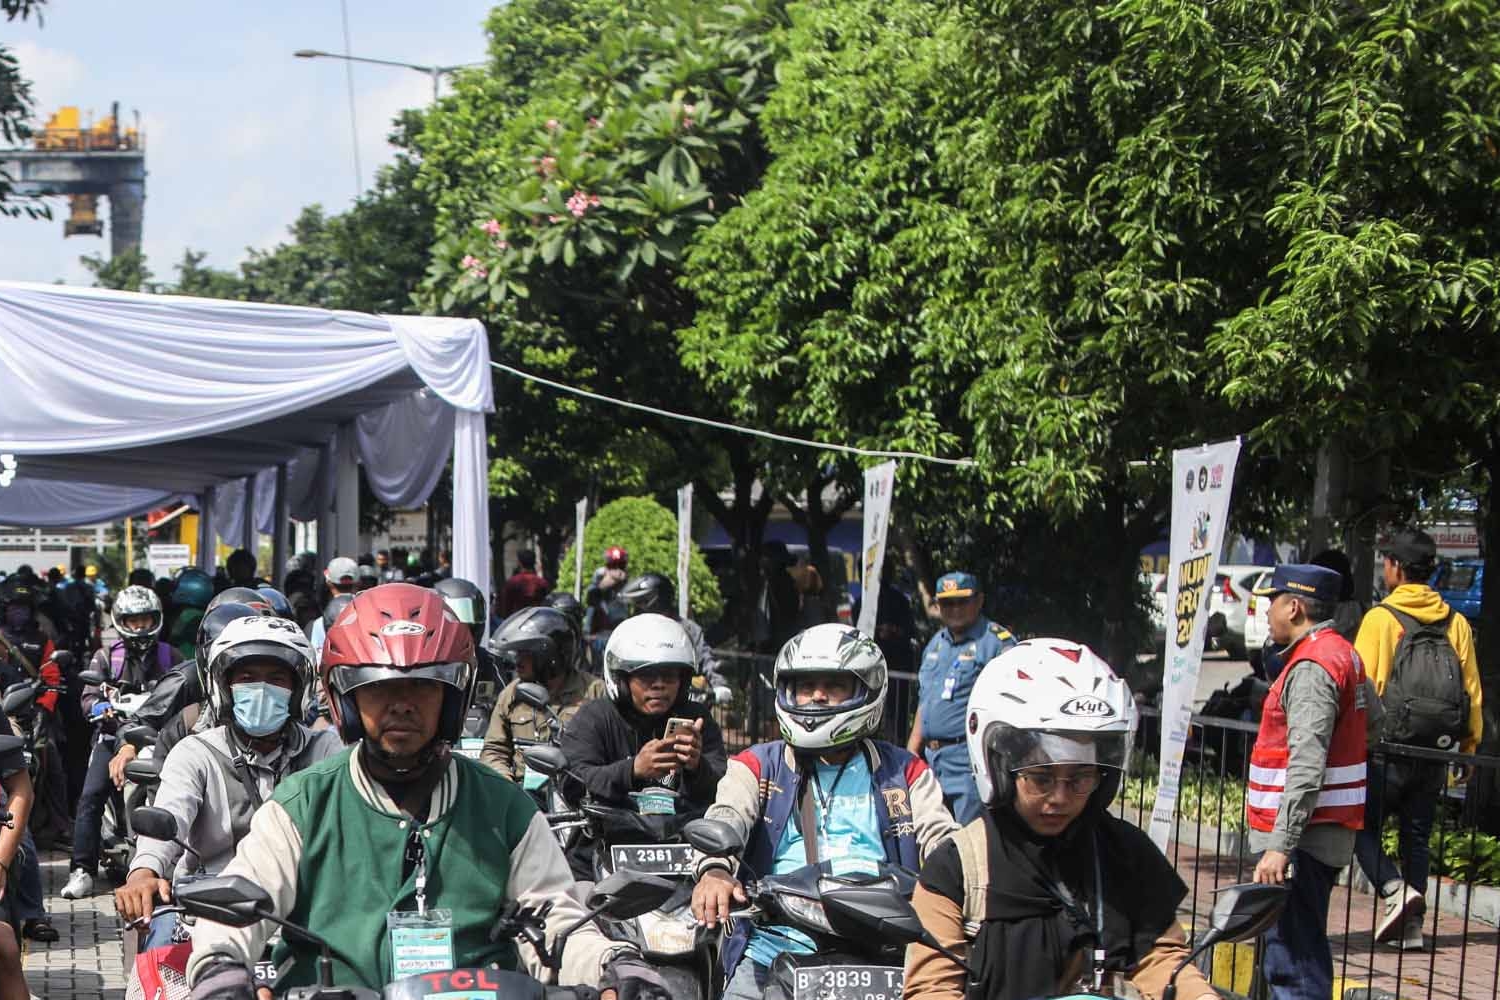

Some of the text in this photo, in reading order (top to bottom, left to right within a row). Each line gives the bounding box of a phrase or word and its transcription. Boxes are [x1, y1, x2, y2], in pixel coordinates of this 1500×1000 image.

[1076, 700, 1106, 713] Kyt
[619, 850, 628, 862] A
[637, 849, 672, 862] 2361
[420, 969, 499, 992] TCL
[798, 973, 809, 989] B
[825, 970, 871, 988] 3839
